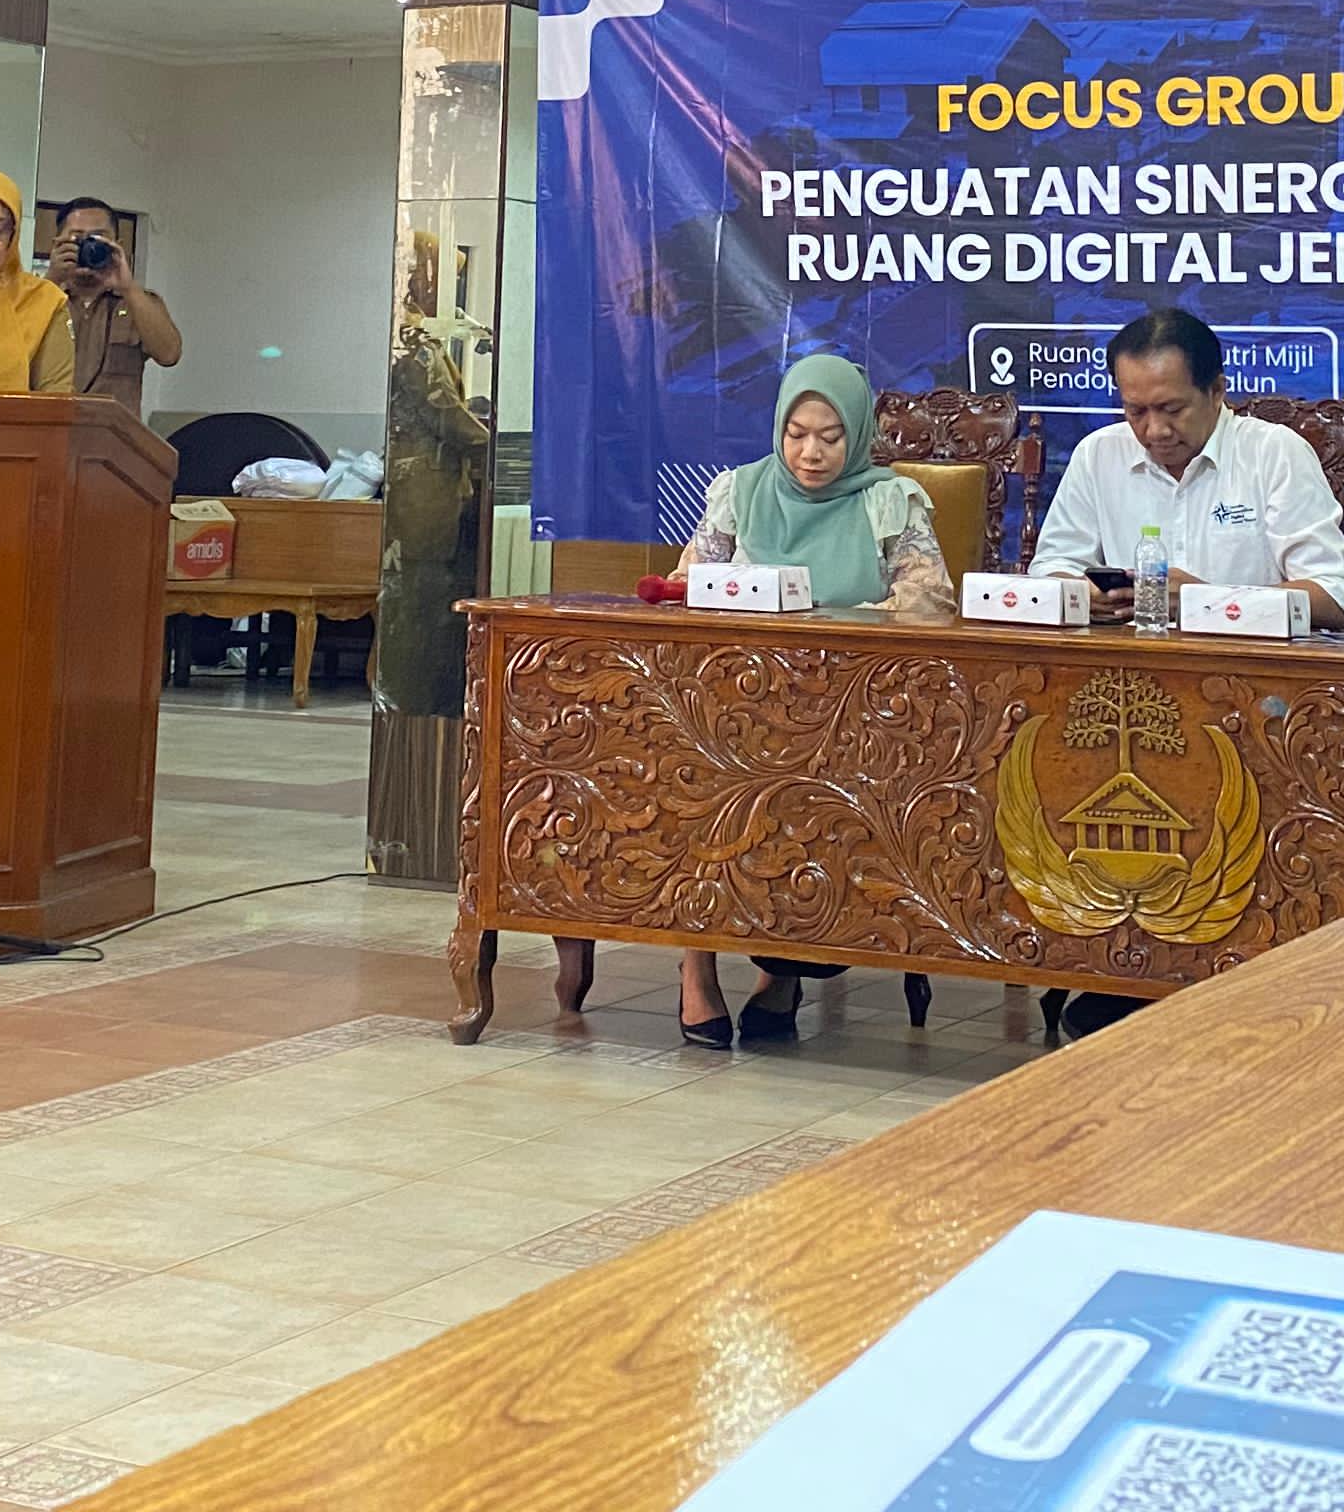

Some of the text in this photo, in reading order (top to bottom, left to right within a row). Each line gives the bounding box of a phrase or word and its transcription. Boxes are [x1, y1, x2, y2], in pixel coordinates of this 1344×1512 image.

[937, 78, 1143, 133] FOCUS
[760, 164, 1121, 218] PENGUATAN
[787, 232, 993, 283] RUANG
[1004, 231, 1248, 284] DIGITAL
[1028, 342, 1108, 370] Ruang
[1264, 344, 1314, 373] Mijil
